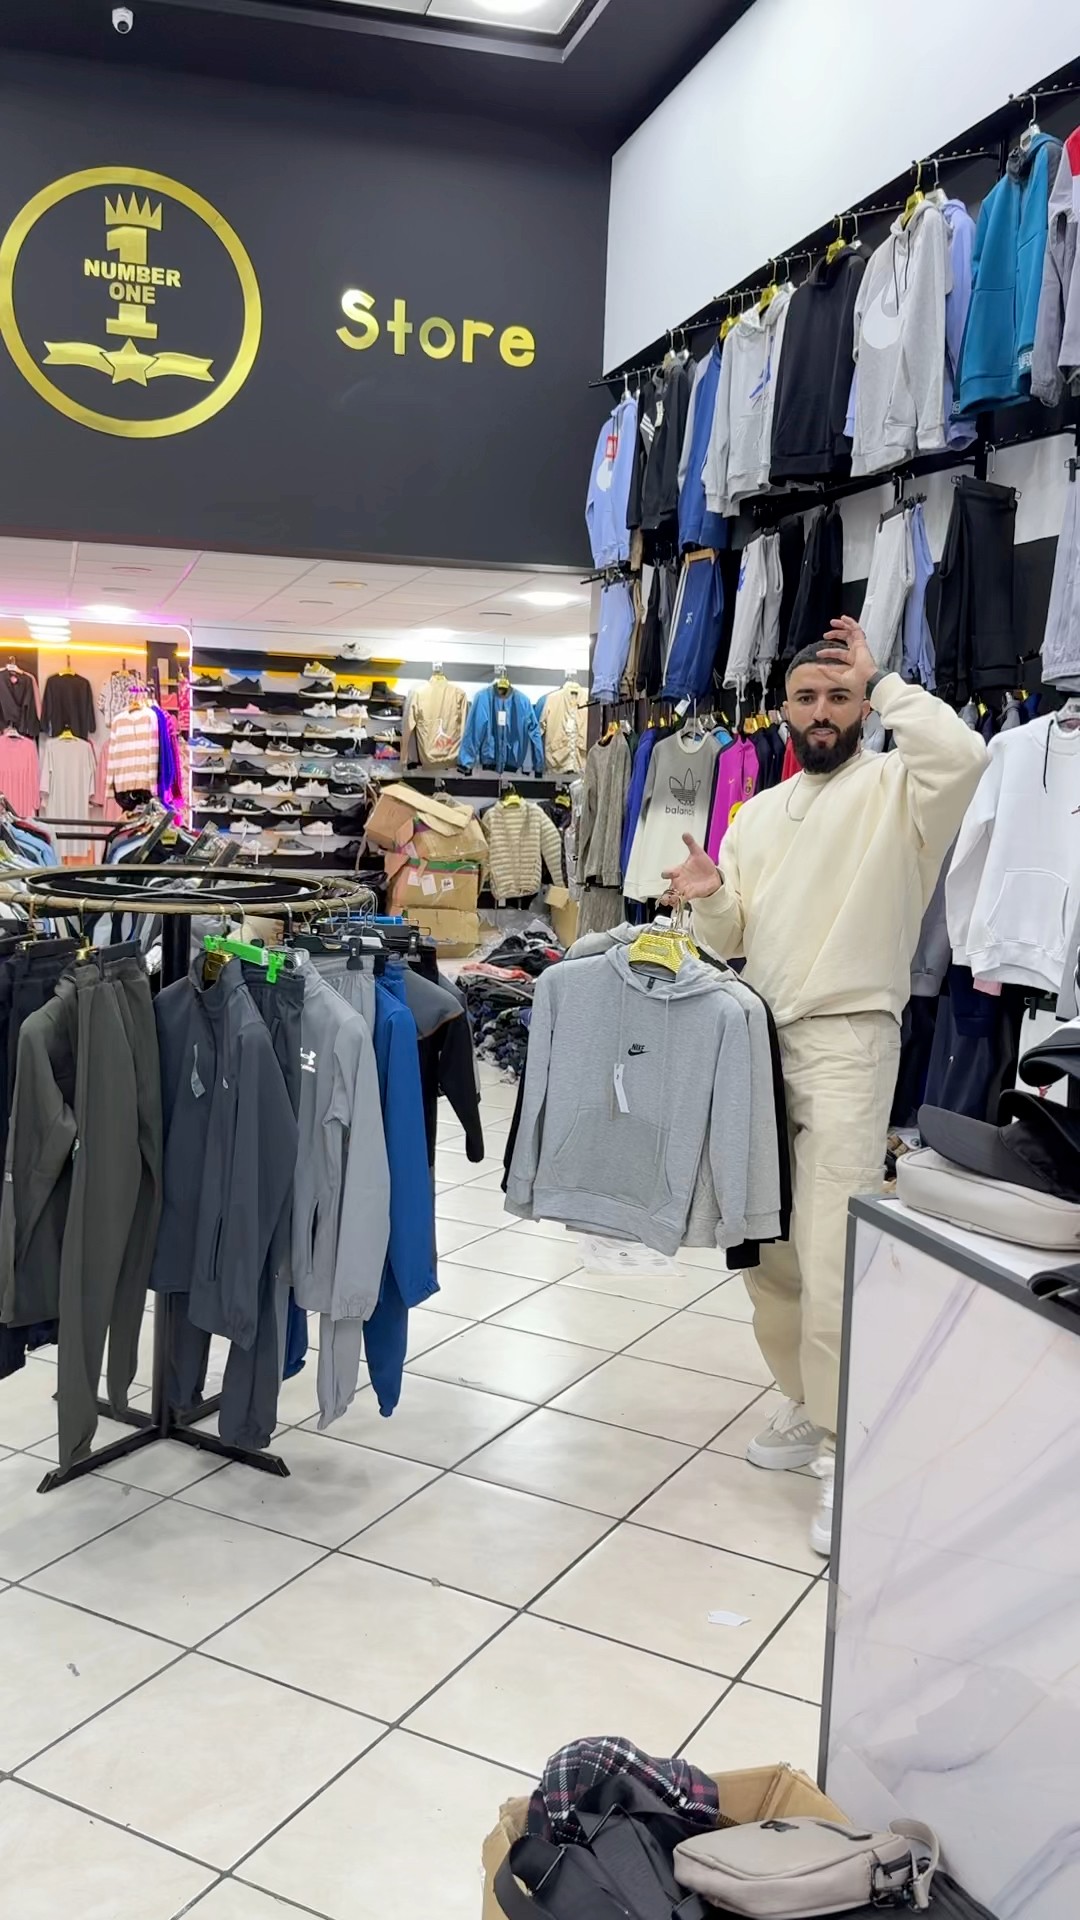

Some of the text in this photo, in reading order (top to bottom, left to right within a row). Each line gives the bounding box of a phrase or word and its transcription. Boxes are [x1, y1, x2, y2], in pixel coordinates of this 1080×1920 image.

[84, 258, 182, 288] NUMBER
[109, 282, 156, 305] ONE
[335, 288, 536, 368] Store
